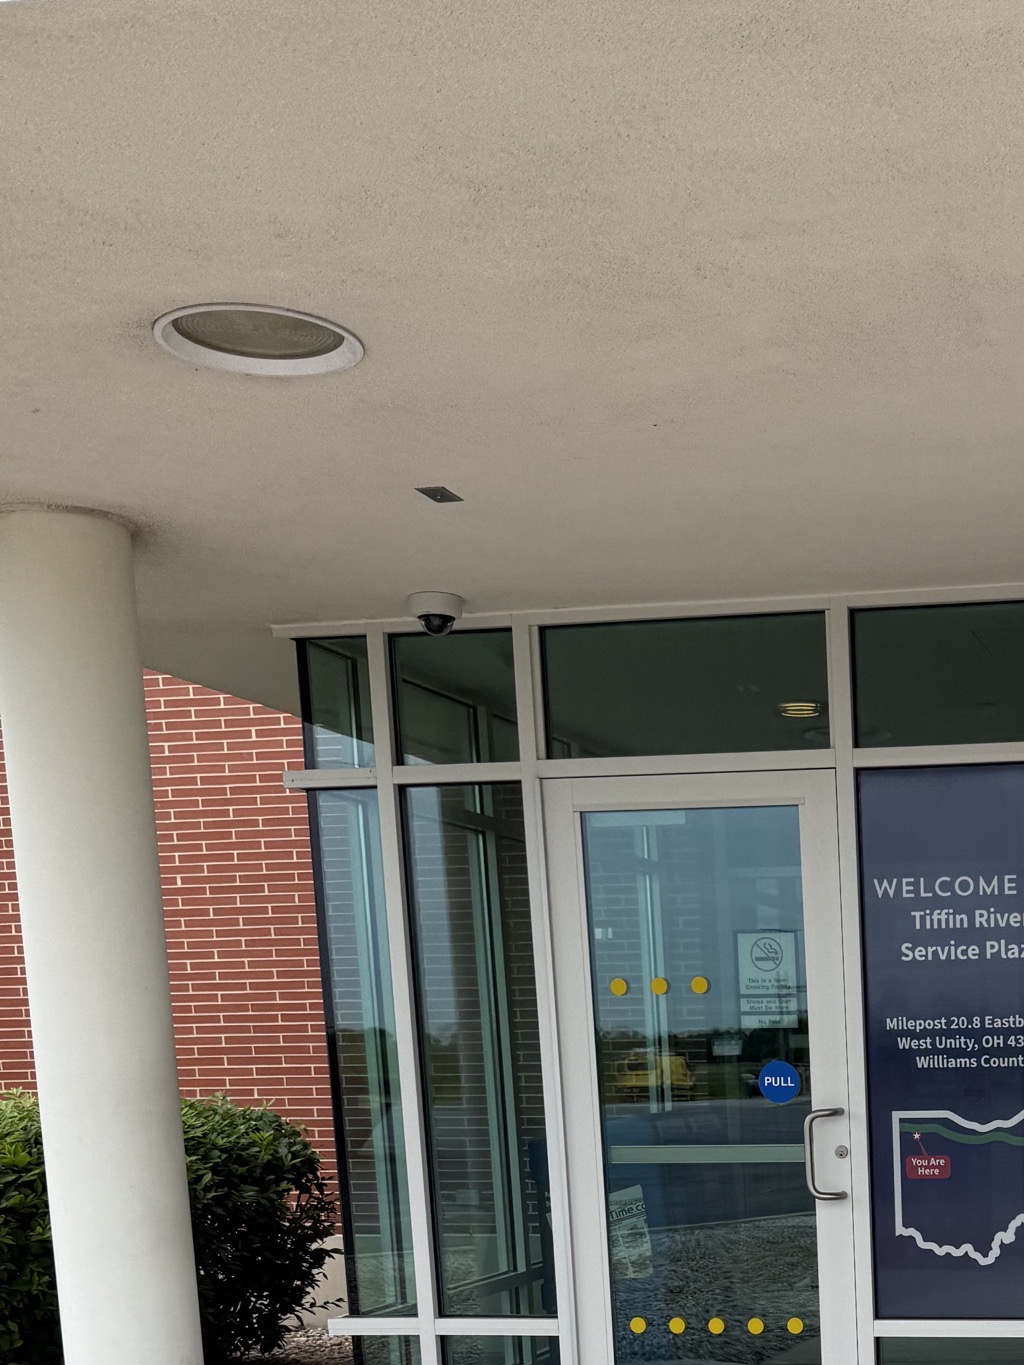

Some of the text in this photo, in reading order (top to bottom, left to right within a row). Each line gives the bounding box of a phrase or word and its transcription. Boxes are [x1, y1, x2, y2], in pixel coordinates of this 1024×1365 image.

[873, 874, 1018, 899] WELCOME
[911, 909, 968, 930] Tiffin
[901, 941, 980, 961] Service
[886, 1016, 947, 1032] Milepost
[950, 1016, 981, 1029] 20.8
[897, 1037, 932, 1049] West
[935, 1036, 979, 1051] Unity,
[982, 1035, 1004, 1048] OH
[916, 1055, 978, 1069] Williams
[764, 1076, 795, 1087] PULL
[911, 1158, 945, 1166] You Are
[918, 1167, 940, 1175] Here
